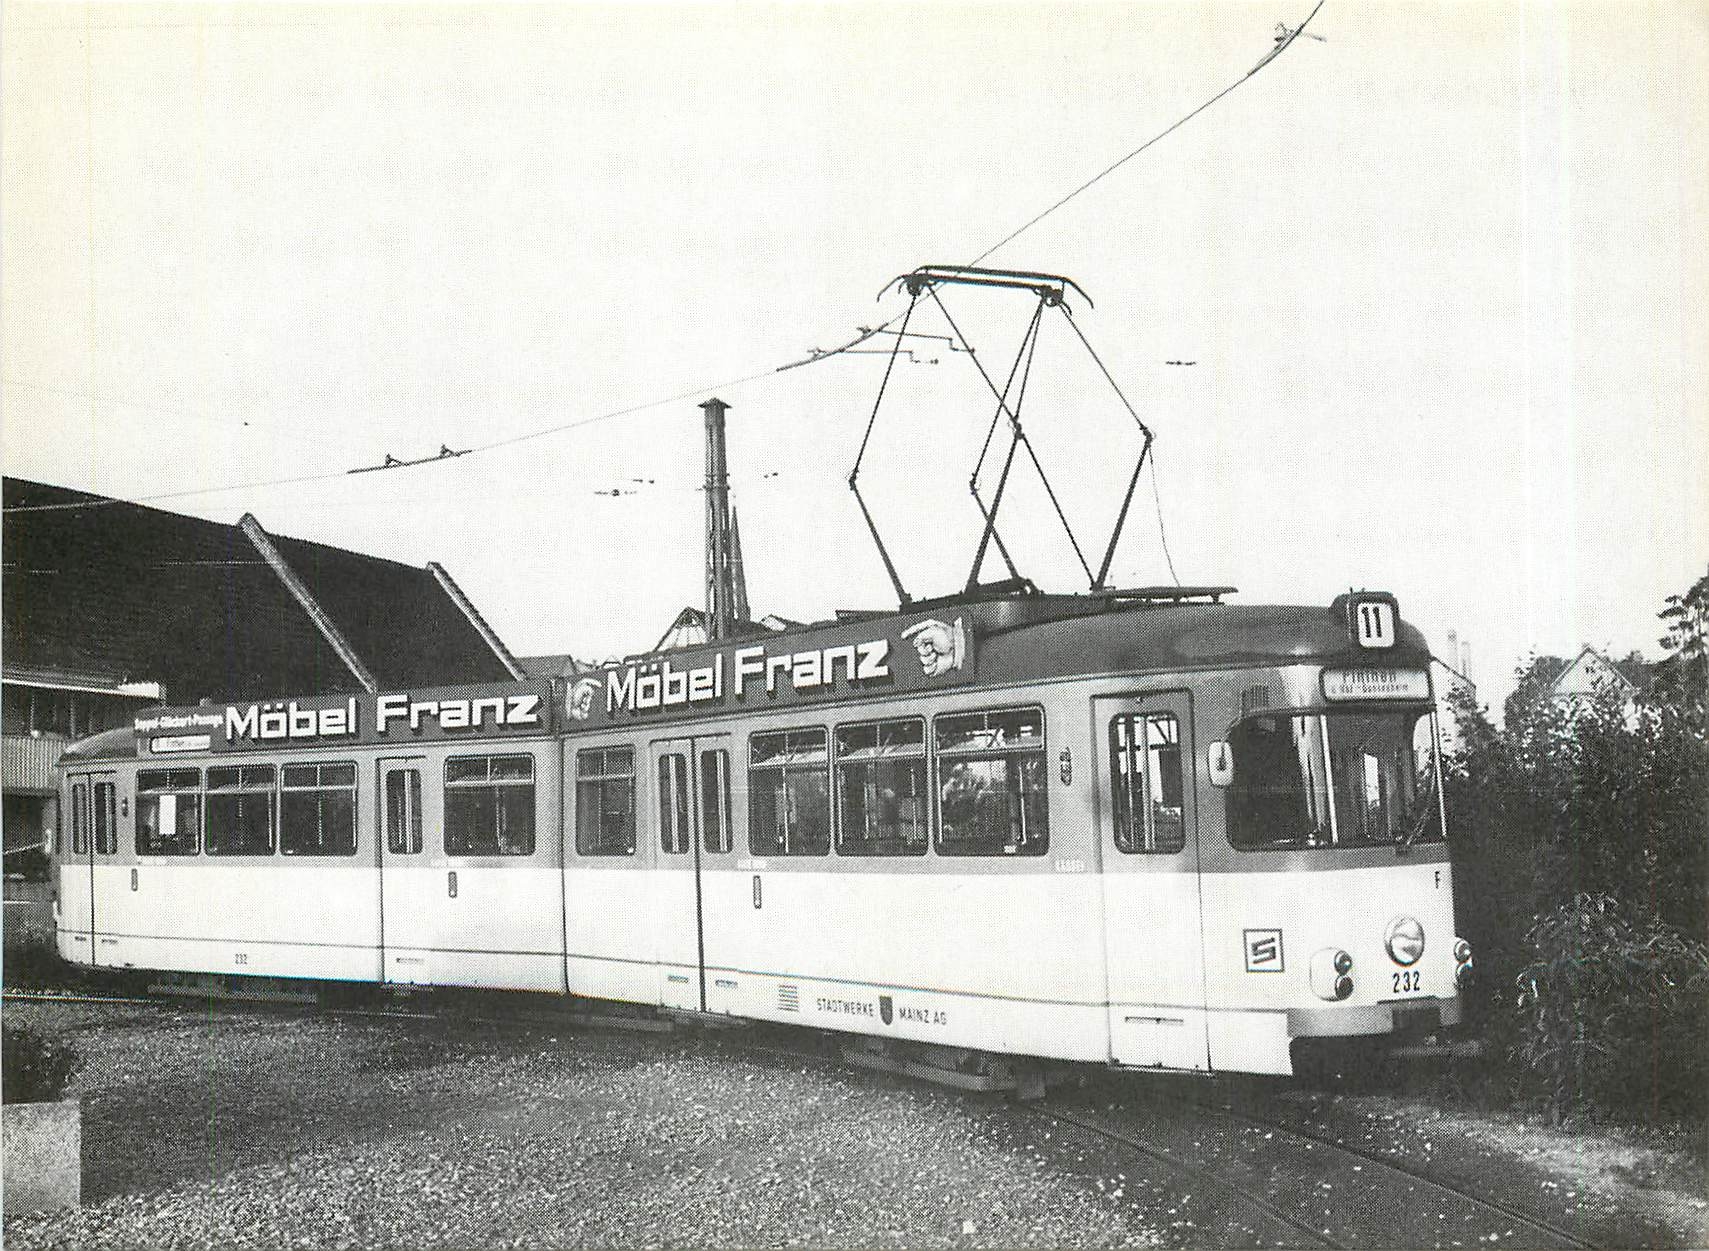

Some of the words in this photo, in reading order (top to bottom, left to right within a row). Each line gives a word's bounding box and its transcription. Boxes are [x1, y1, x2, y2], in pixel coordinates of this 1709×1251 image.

[1361, 606, 1382, 638] 11
[606, 652, 723, 713] Möbel
[735, 638, 889, 695] Franz
[225, 697, 356, 740] Möbel
[376, 694, 539, 732] Franz
[1434, 870, 1441, 889] F
[1392, 970, 1421, 993] 232
[816, 997, 875, 1018] STADTWERKE
[899, 1007, 930, 1024] MAINZ
[933, 1010, 948, 1026] AG
